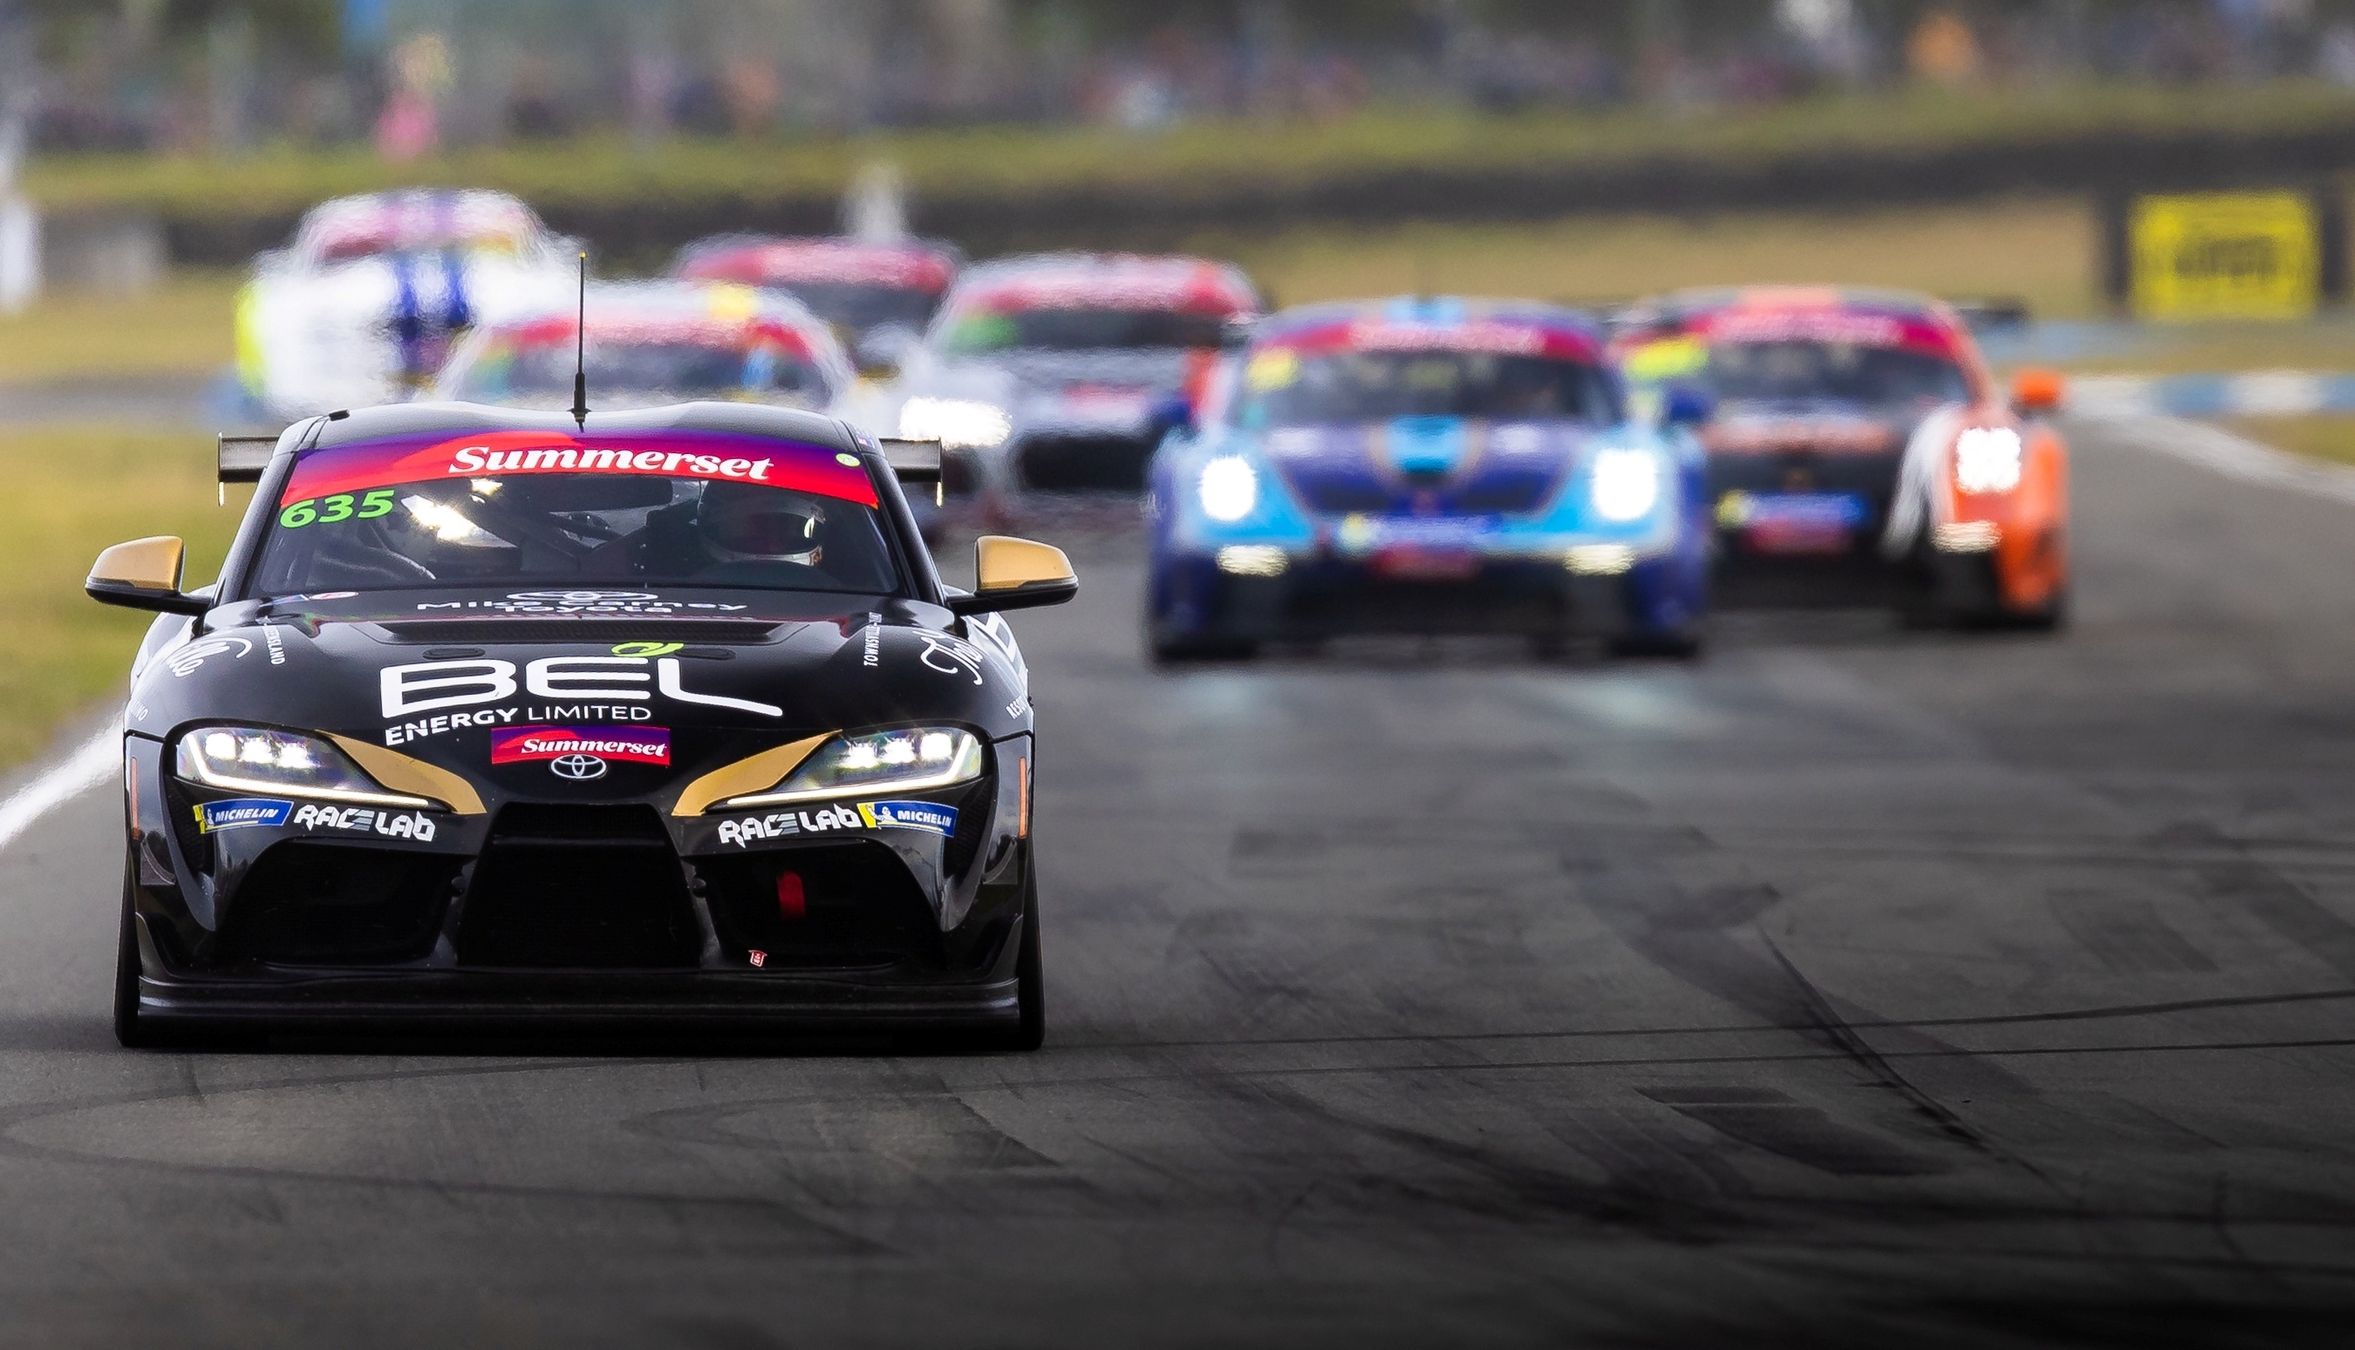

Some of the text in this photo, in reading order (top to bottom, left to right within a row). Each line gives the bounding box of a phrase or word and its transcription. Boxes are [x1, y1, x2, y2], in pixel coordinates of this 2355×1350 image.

[448, 445, 774, 482] Summerset
[279, 489, 396, 529] 635
[496, 605, 673, 614] Toyota
[380, 657, 784, 719] BEL
[385, 705, 652, 747] ENERGY LIMITED
[520, 738, 667, 758] Summerset
[214, 807, 279, 822] MICHELIN
[896, 809, 953, 828] MICHELIN
